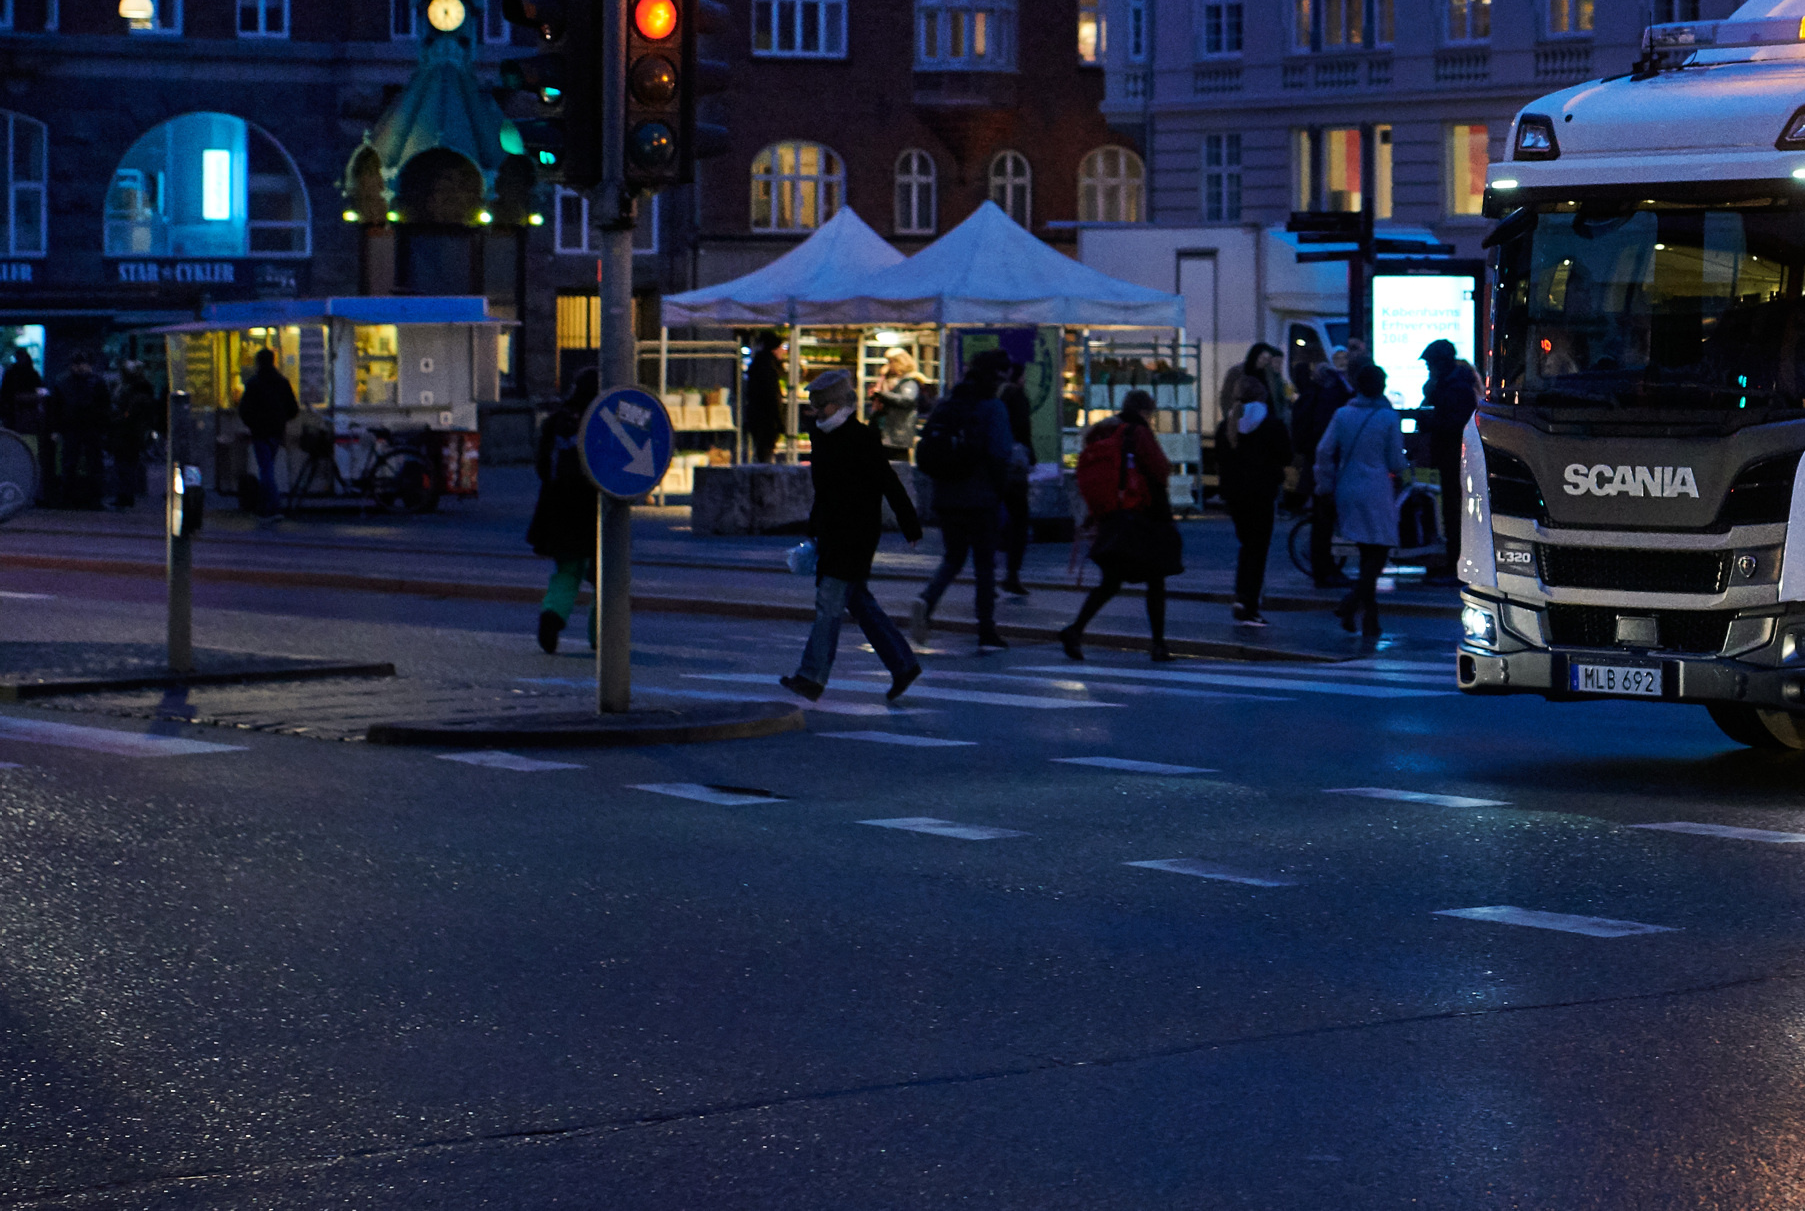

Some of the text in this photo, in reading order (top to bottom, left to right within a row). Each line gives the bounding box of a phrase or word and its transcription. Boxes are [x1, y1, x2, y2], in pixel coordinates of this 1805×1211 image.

[1382, 307, 1461, 317] Københavns
[1382, 333, 1409, 344] 2018
[1563, 463, 1700, 498] SCANIA
[1497, 551, 1531, 563] L 320
[1584, 667, 1654, 692] MLB 692
